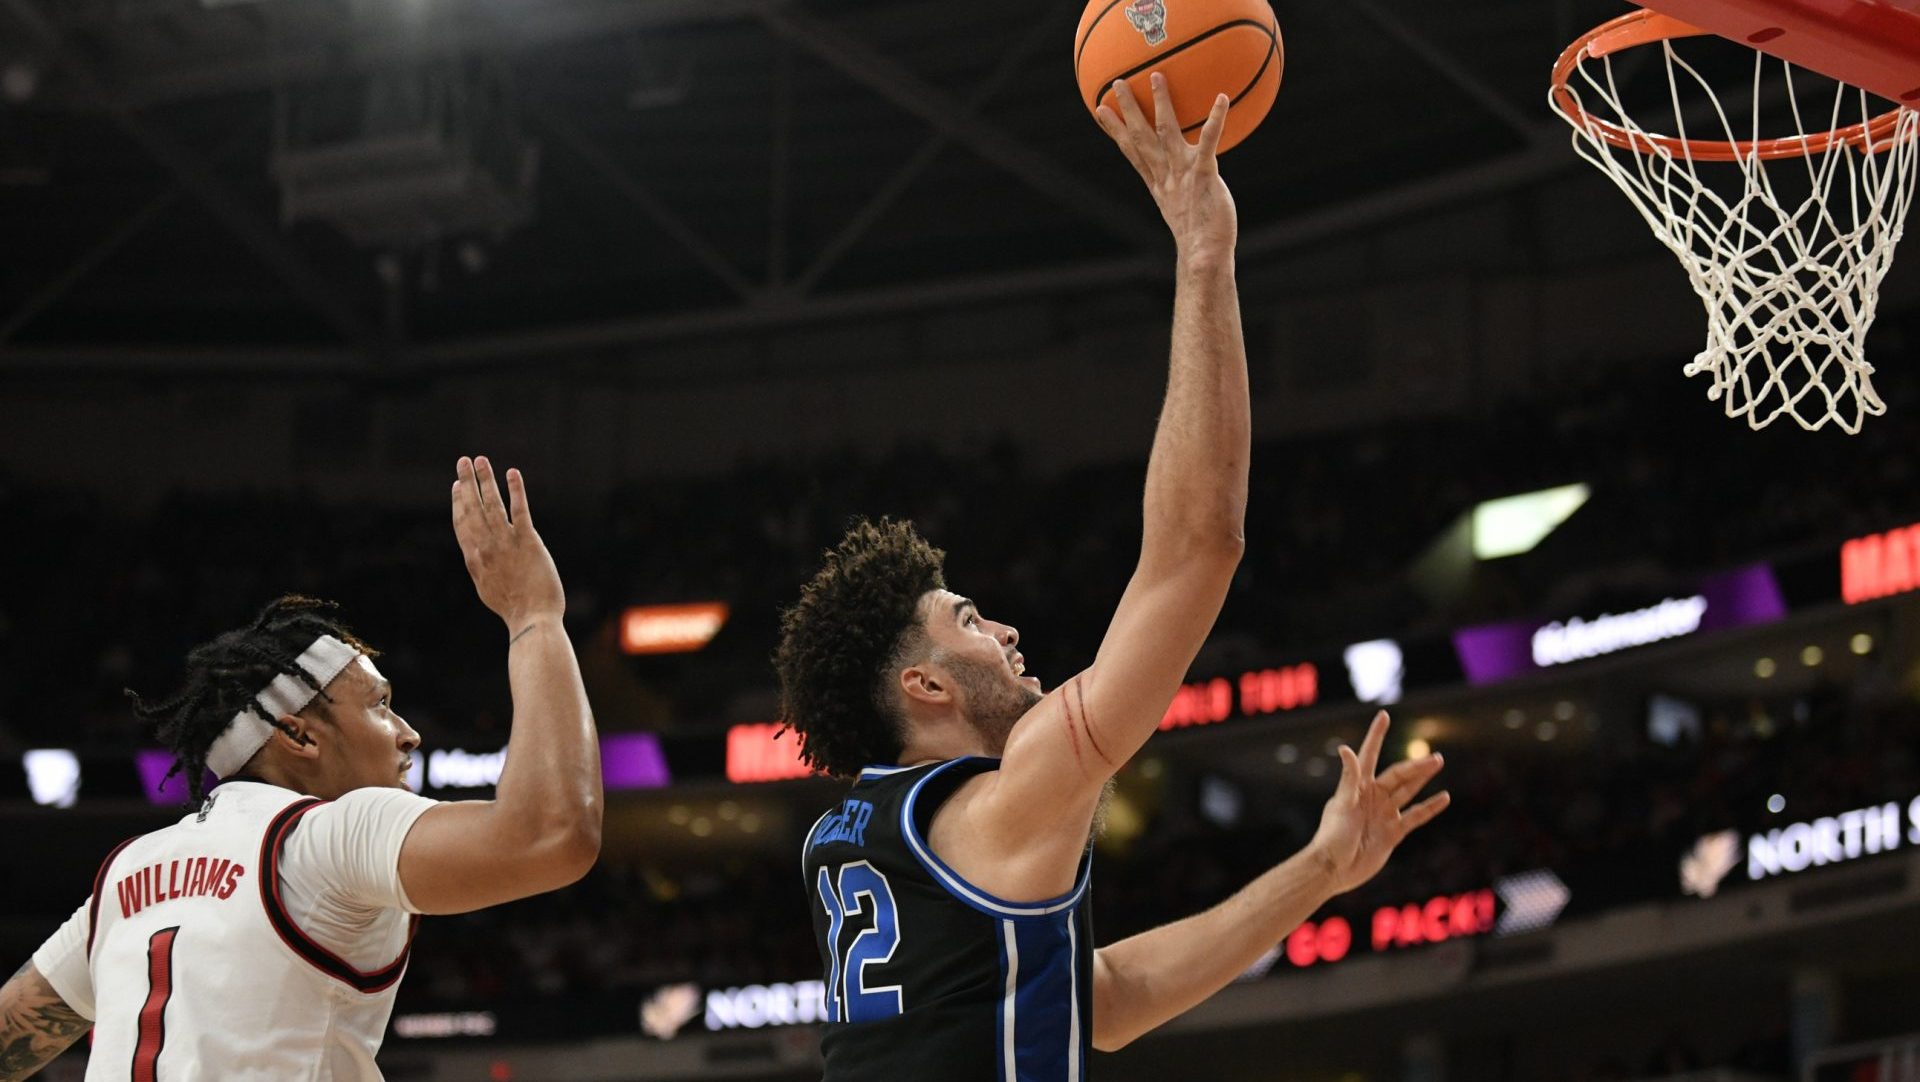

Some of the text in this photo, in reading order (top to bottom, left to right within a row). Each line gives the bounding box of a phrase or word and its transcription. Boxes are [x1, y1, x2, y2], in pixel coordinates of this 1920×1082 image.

[1749, 802, 1899, 879] NORTH
[117, 857, 244, 919] WILLIAMS
[818, 859, 903, 1022] 12
[1287, 917, 1351, 966] GO
[131, 925, 180, 1082] 1
